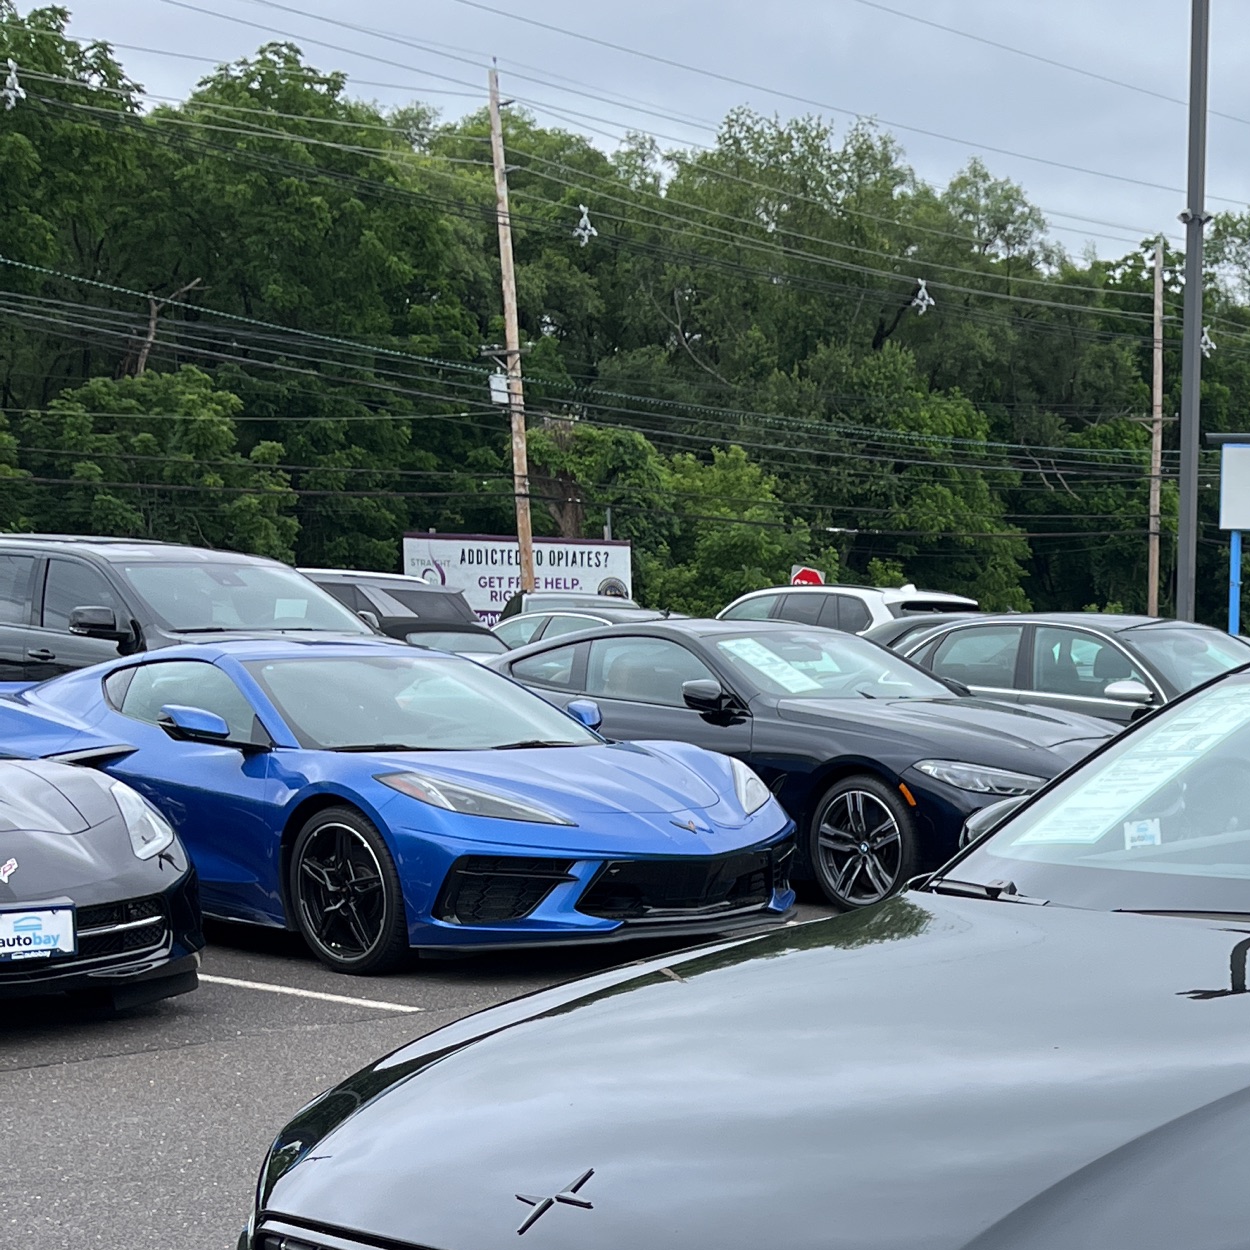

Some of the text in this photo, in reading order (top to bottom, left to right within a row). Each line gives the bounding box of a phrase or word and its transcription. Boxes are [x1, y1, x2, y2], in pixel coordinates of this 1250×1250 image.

[460, 548, 609, 568] ADDICTED O OPIATES?
[478, 576, 504, 588] GET
[508, 576, 541, 589] FE
[545, 577, 583, 590] HELP.
[490, 590, 516, 602] RIG
[0, 932, 60, 948] autobay
